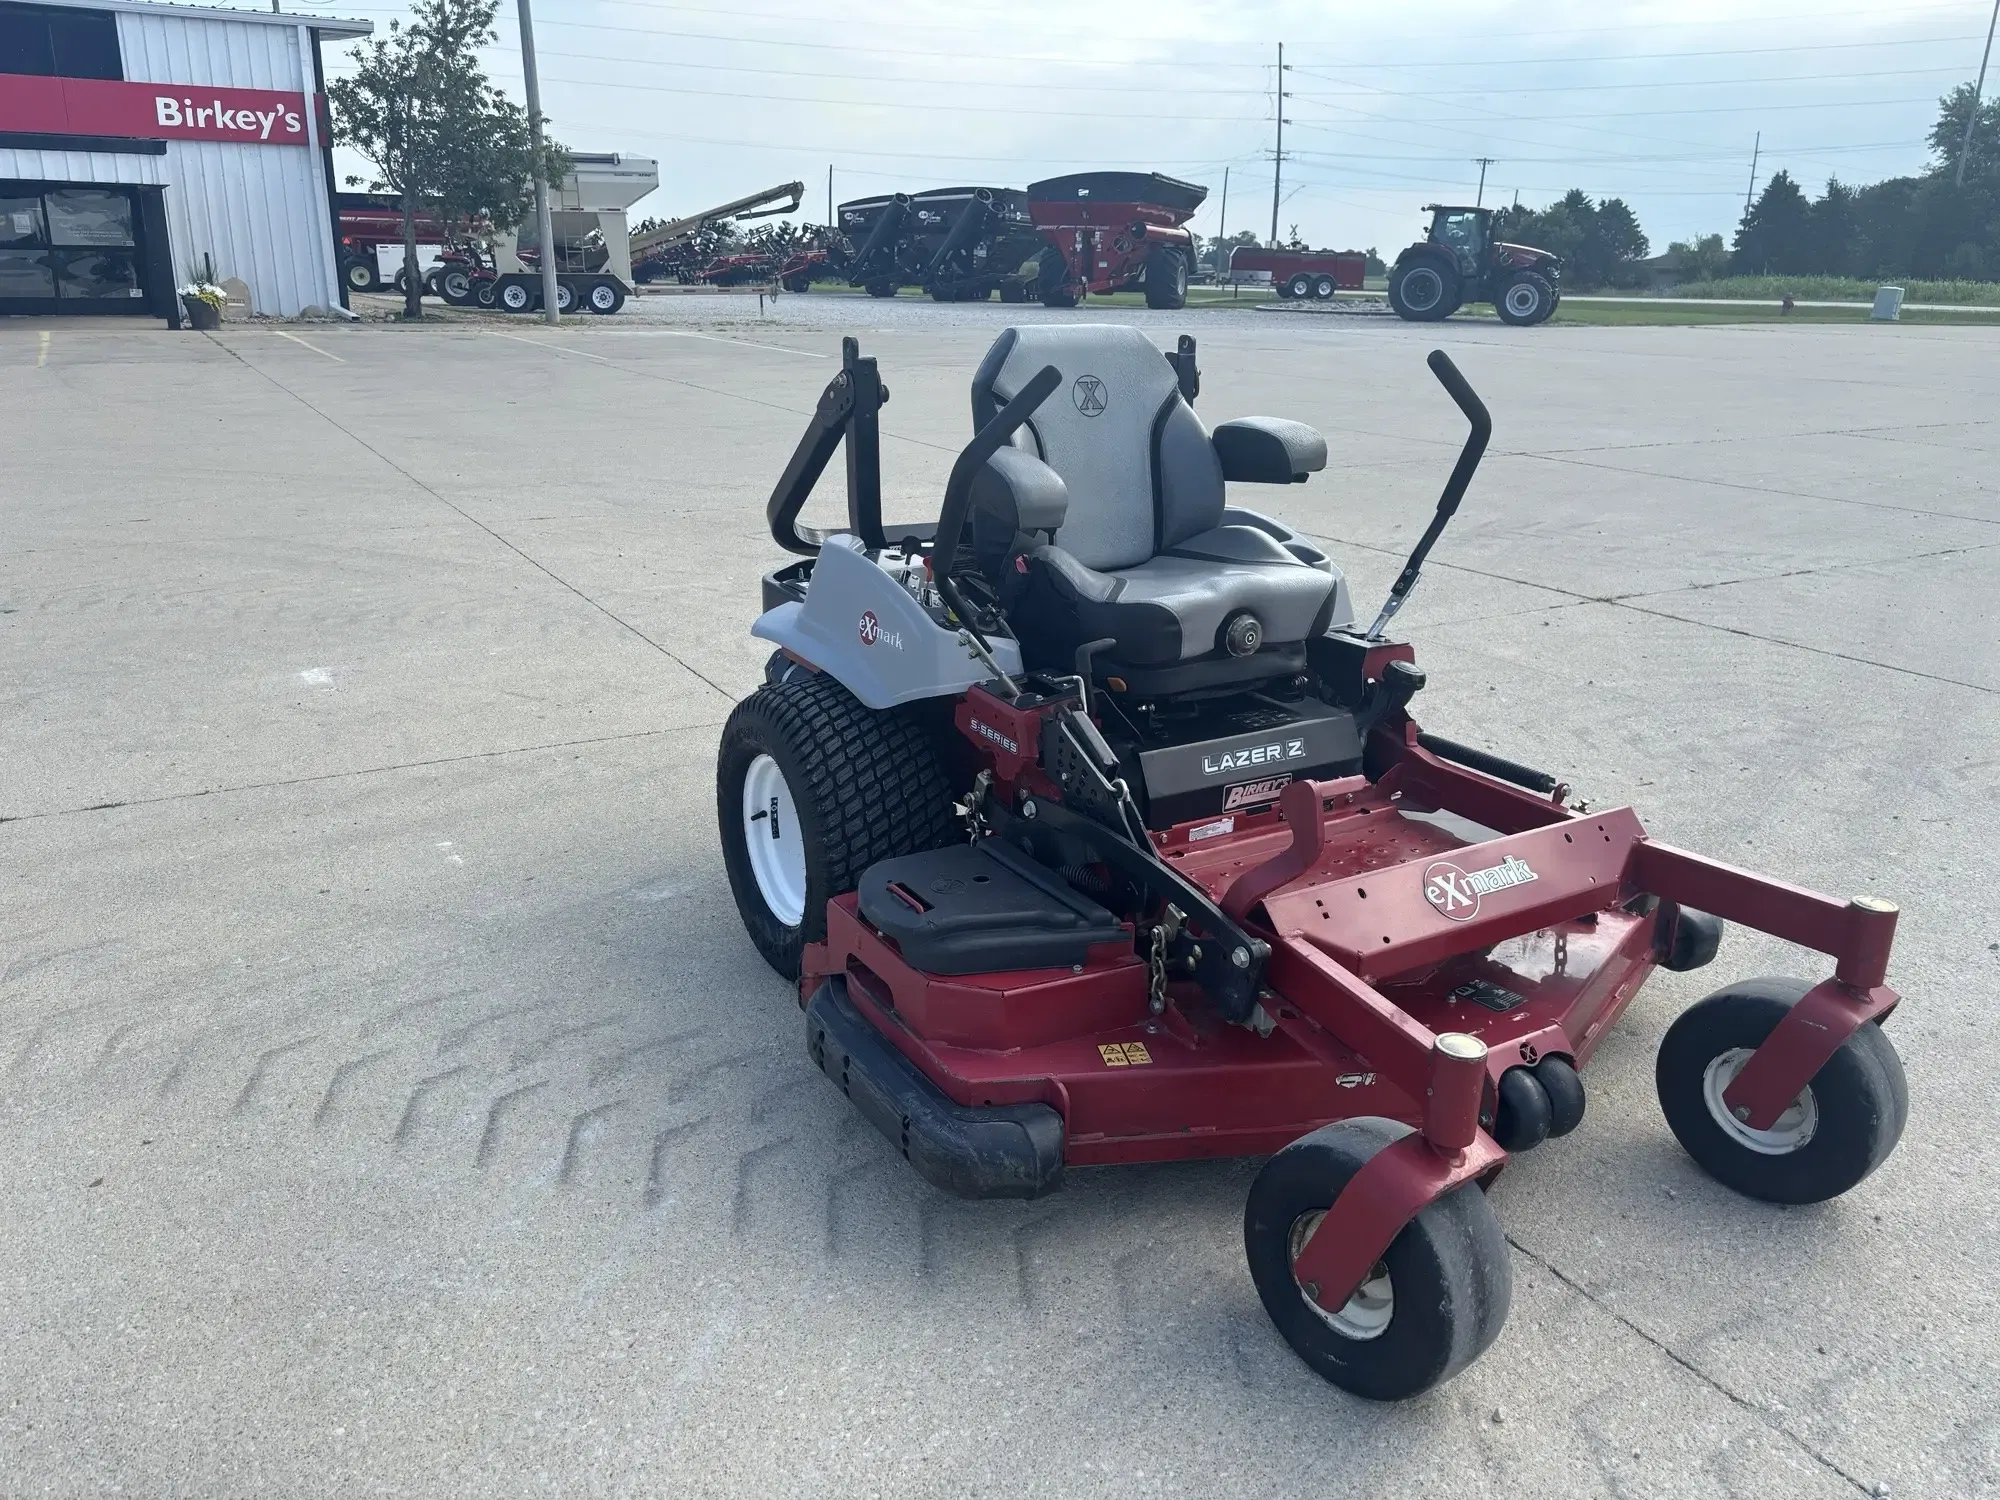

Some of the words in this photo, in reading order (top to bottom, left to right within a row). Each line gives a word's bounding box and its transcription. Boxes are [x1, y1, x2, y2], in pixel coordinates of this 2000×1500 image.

[155, 96, 302, 140] Birkey's
[970, 718, 1018, 754] S-SERIES
[1203, 743, 1283, 774] LAZER
[1287, 740, 1303, 758] Z
[1425, 856, 1535, 912] eXmark
